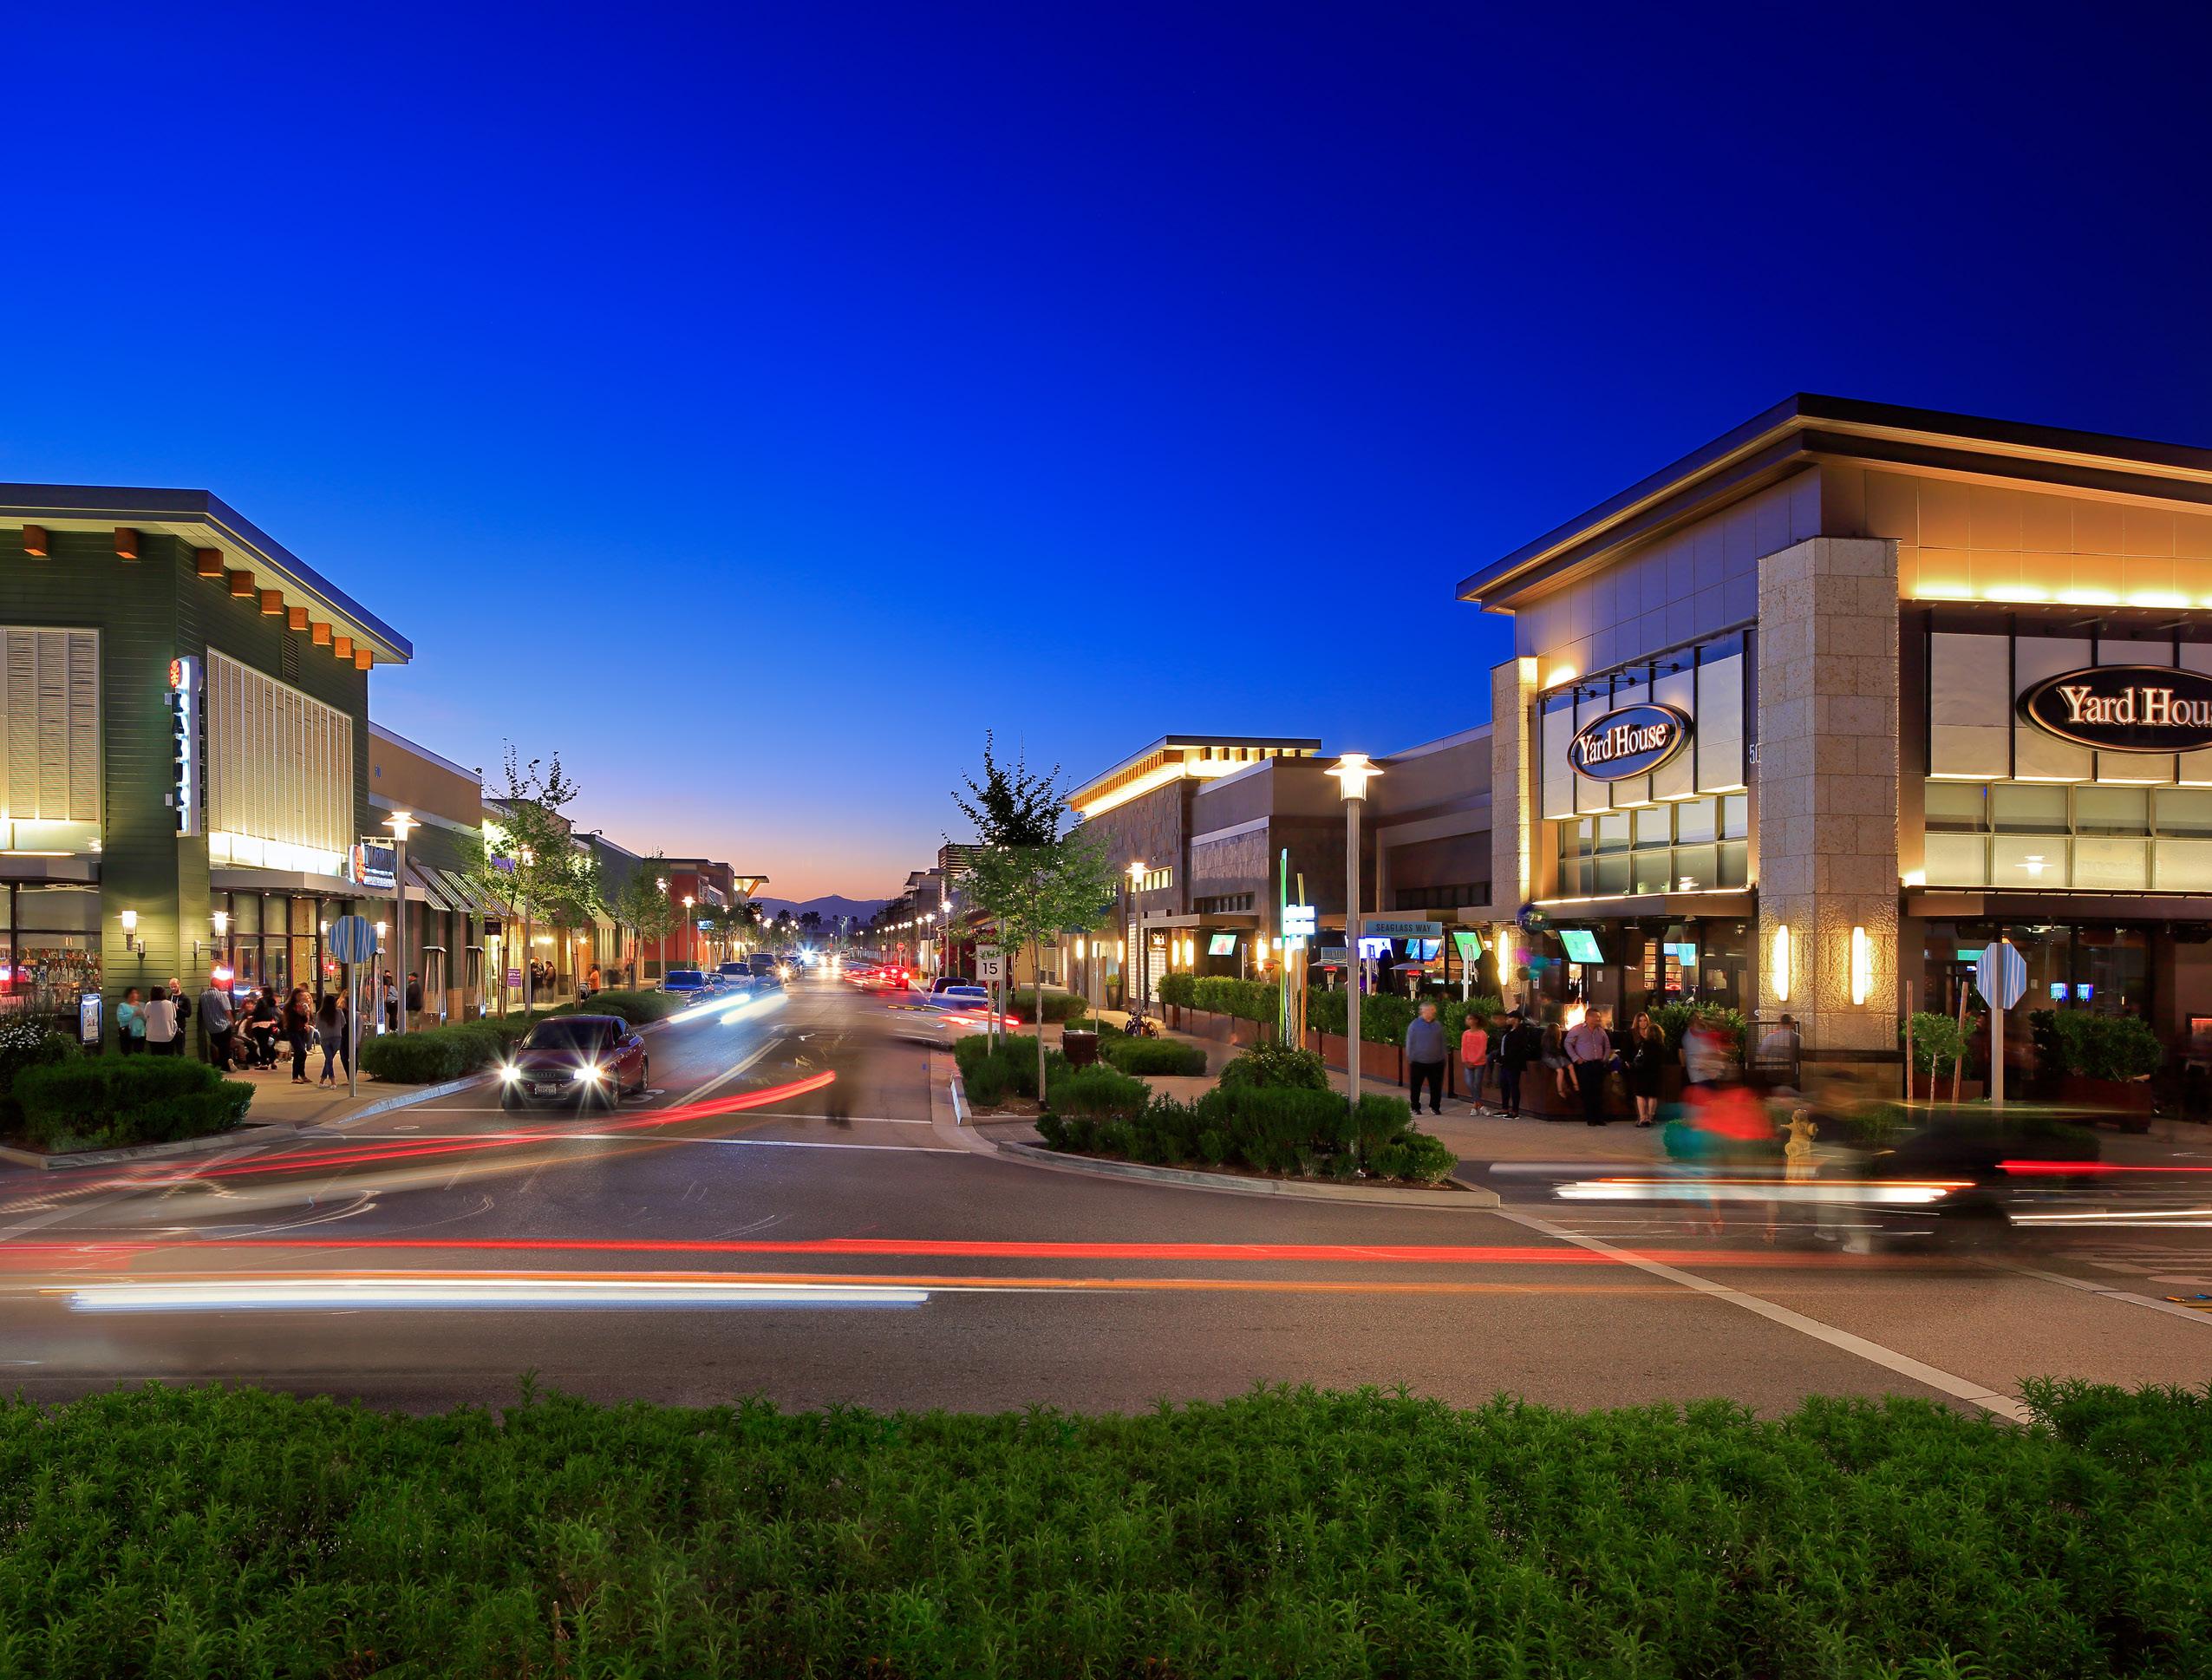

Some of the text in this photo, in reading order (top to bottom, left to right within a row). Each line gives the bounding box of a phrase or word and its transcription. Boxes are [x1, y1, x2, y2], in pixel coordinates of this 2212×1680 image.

[2058, 685, 2212, 726] Yard Hou
[1577, 722, 1667, 766] Yard House
[1376, 923, 1432, 932] SEAGLASS WAY
[982, 962, 998, 975] 15
